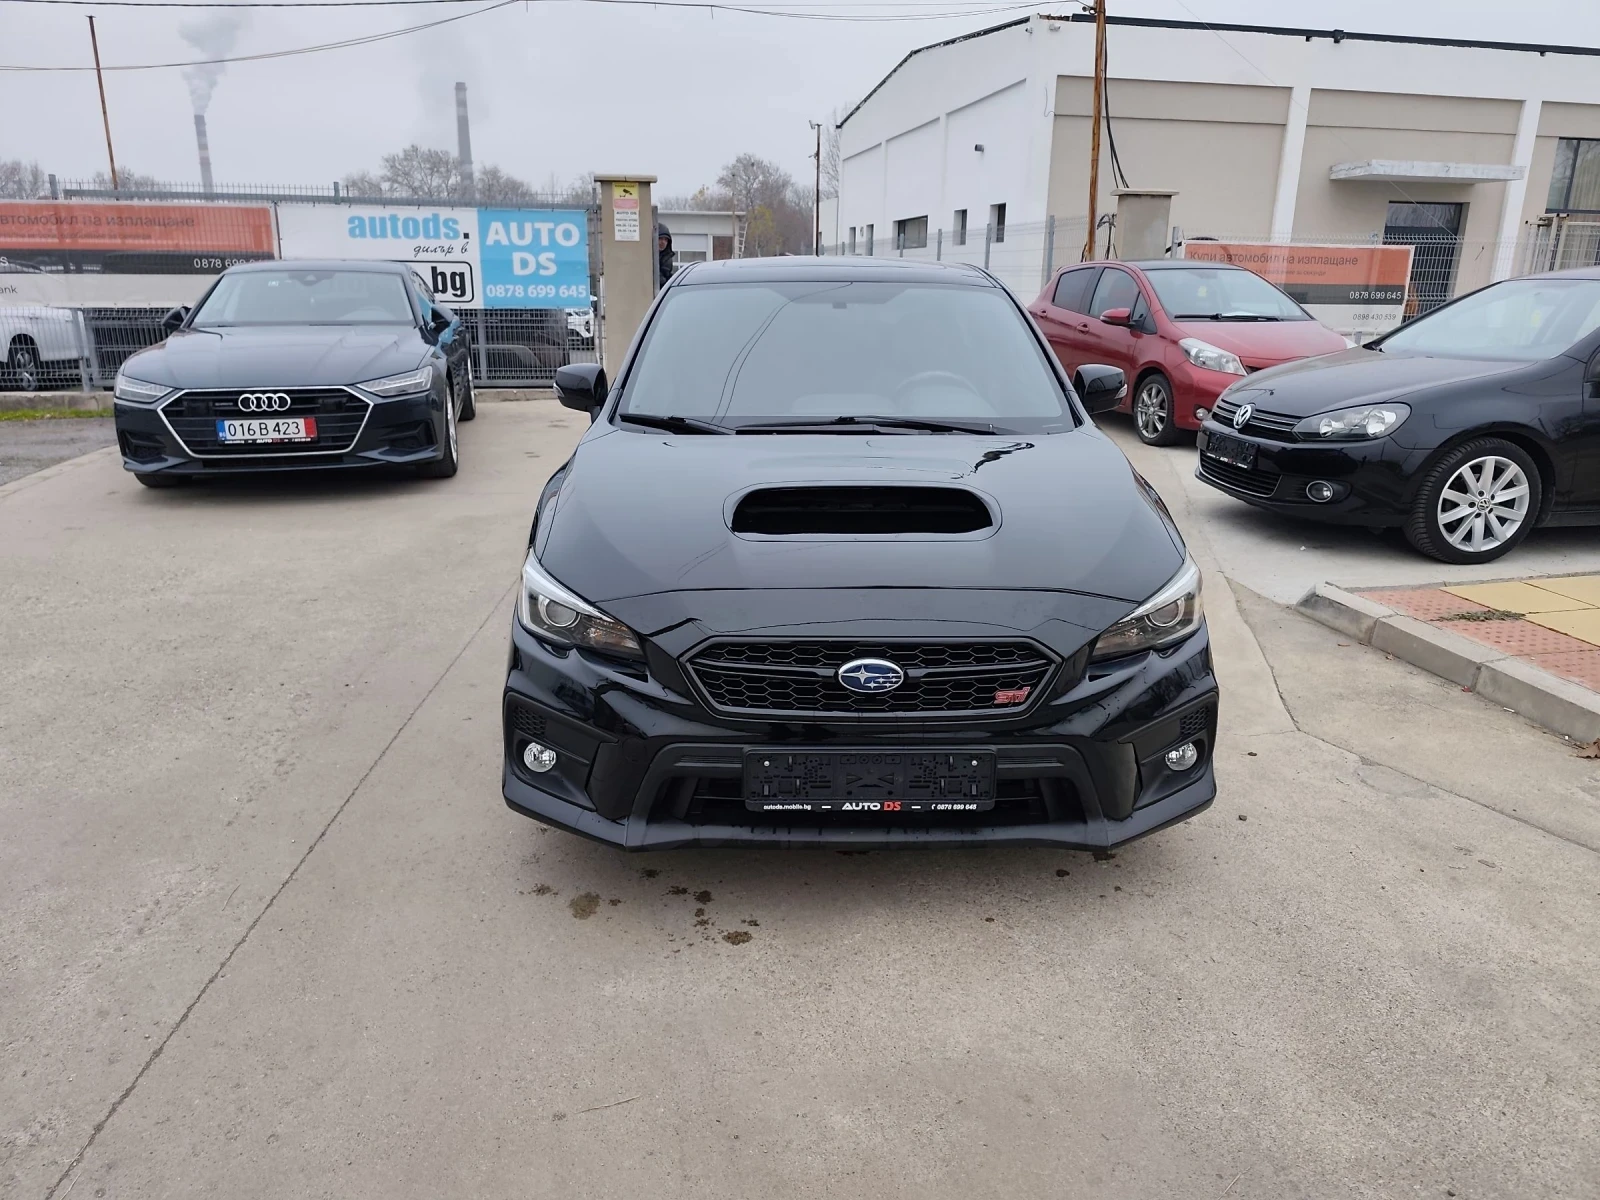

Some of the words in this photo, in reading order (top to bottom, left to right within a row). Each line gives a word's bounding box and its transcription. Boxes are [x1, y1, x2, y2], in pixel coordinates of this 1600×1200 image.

[82, 215, 102, 226] на
[106, 215, 195, 228] изплащане
[347, 213, 470, 240] autods.
[485, 221, 580, 247] AUTO
[413, 244, 454, 258] дилър
[193, 258, 222, 269] 0878
[512, 251, 557, 276] DS
[1219, 252, 1281, 264] автомобил
[1282, 255, 1295, 265] на
[1297, 255, 1359, 266] изплащане
[430, 265, 467, 298] bg
[486, 284, 524, 298] 0878
[528, 285, 556, 298] 699
[559, 285, 587, 298] 645
[1349, 291, 1369, 300] 0878
[1370, 291, 1386, 300] 699
[1386, 291, 1402, 300] 645
[1352, 313, 1370, 321] 0898
[228, 423, 256, 437] 016
[258, 422, 269, 436] B
[272, 421, 301, 436] 423
[841, 802, 881, 810] AUTO
[883, 801, 902, 811] DS
